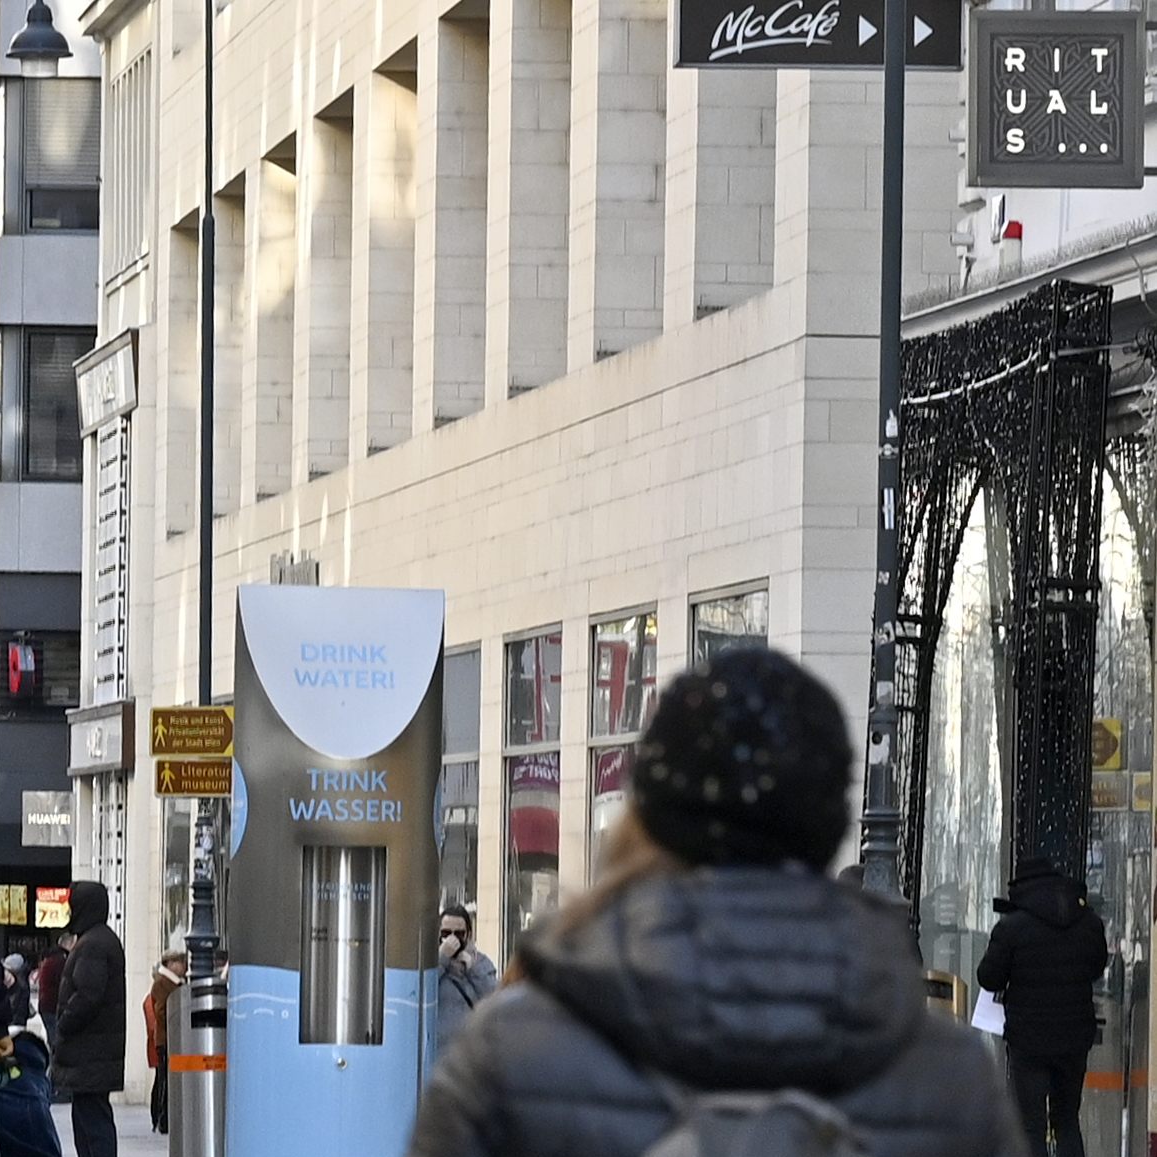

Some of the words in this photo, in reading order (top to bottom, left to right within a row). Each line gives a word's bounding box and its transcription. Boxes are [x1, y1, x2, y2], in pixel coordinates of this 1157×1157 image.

[709, 0, 840, 55] McCafé
[300, 643, 388, 663] DRINK
[294, 668, 395, 688] WATER!
[190, 715, 203, 724] und
[172, 738, 183, 747] der
[181, 780, 230, 790] museum
[307, 769, 388, 793] TRINK
[27, 812, 70, 825] HUAWEI
[289, 798, 403, 822] WASSER!
